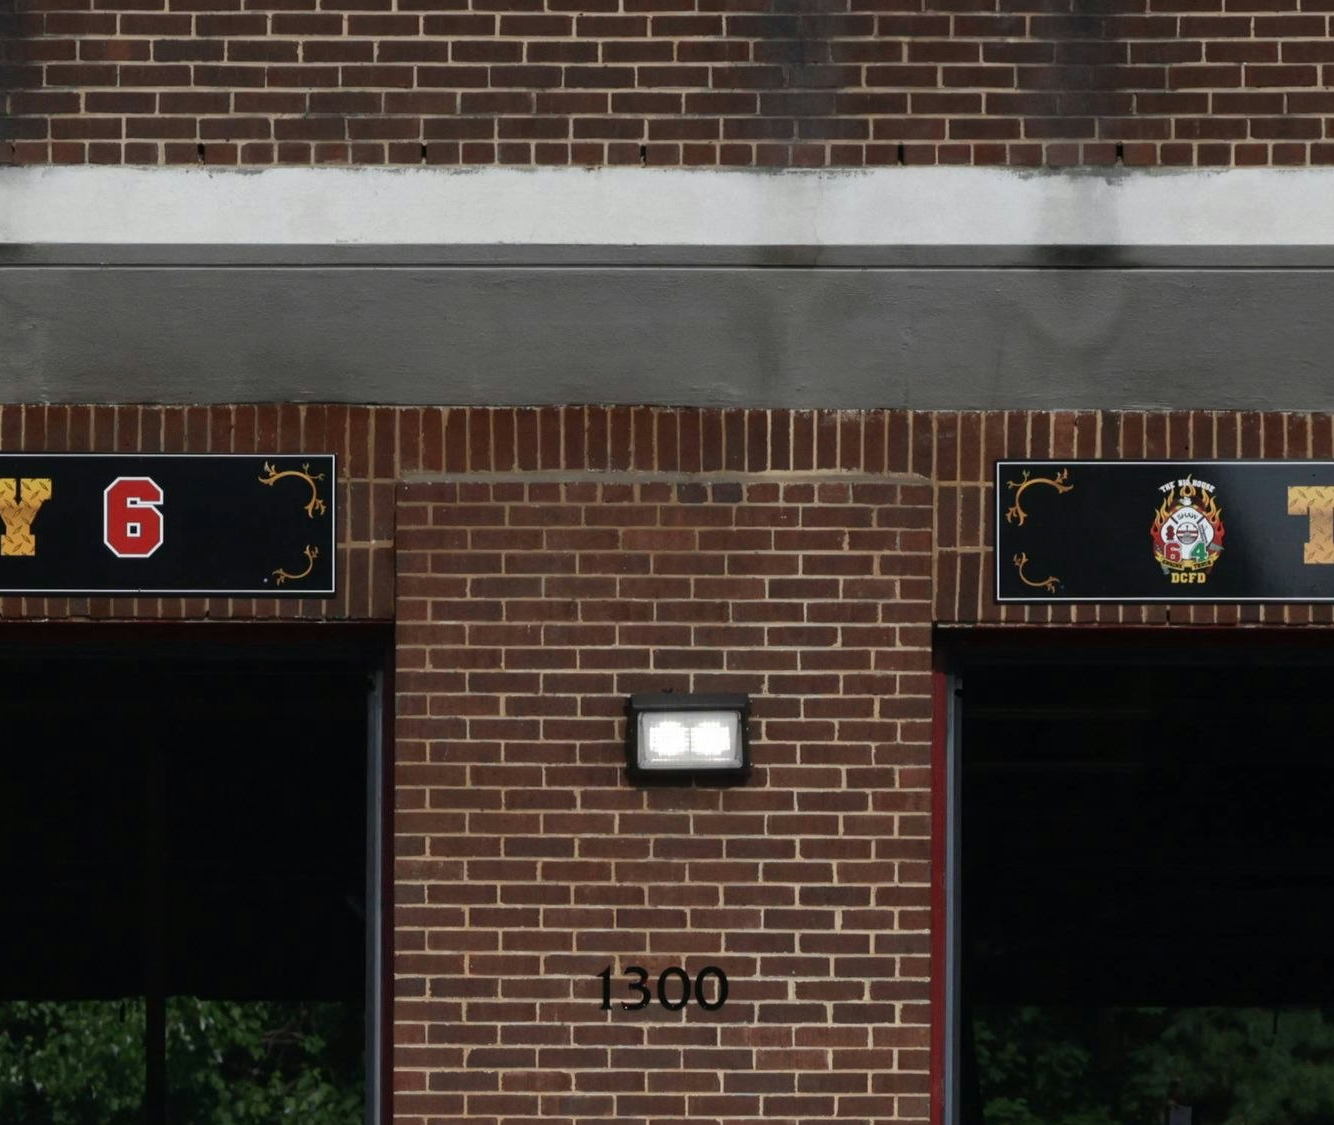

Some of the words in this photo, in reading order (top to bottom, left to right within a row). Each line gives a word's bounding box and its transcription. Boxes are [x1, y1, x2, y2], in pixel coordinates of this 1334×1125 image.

[1158, 480, 1175, 493] THE
[1192, 479, 1216, 493] HOUSE
[103, 476, 164, 558] 6
[1164, 542, 1182, 563] 6
[1190, 542, 1209, 562] 4
[1171, 572, 1207, 583] DCFD
[595, 965, 729, 1012] 1300
